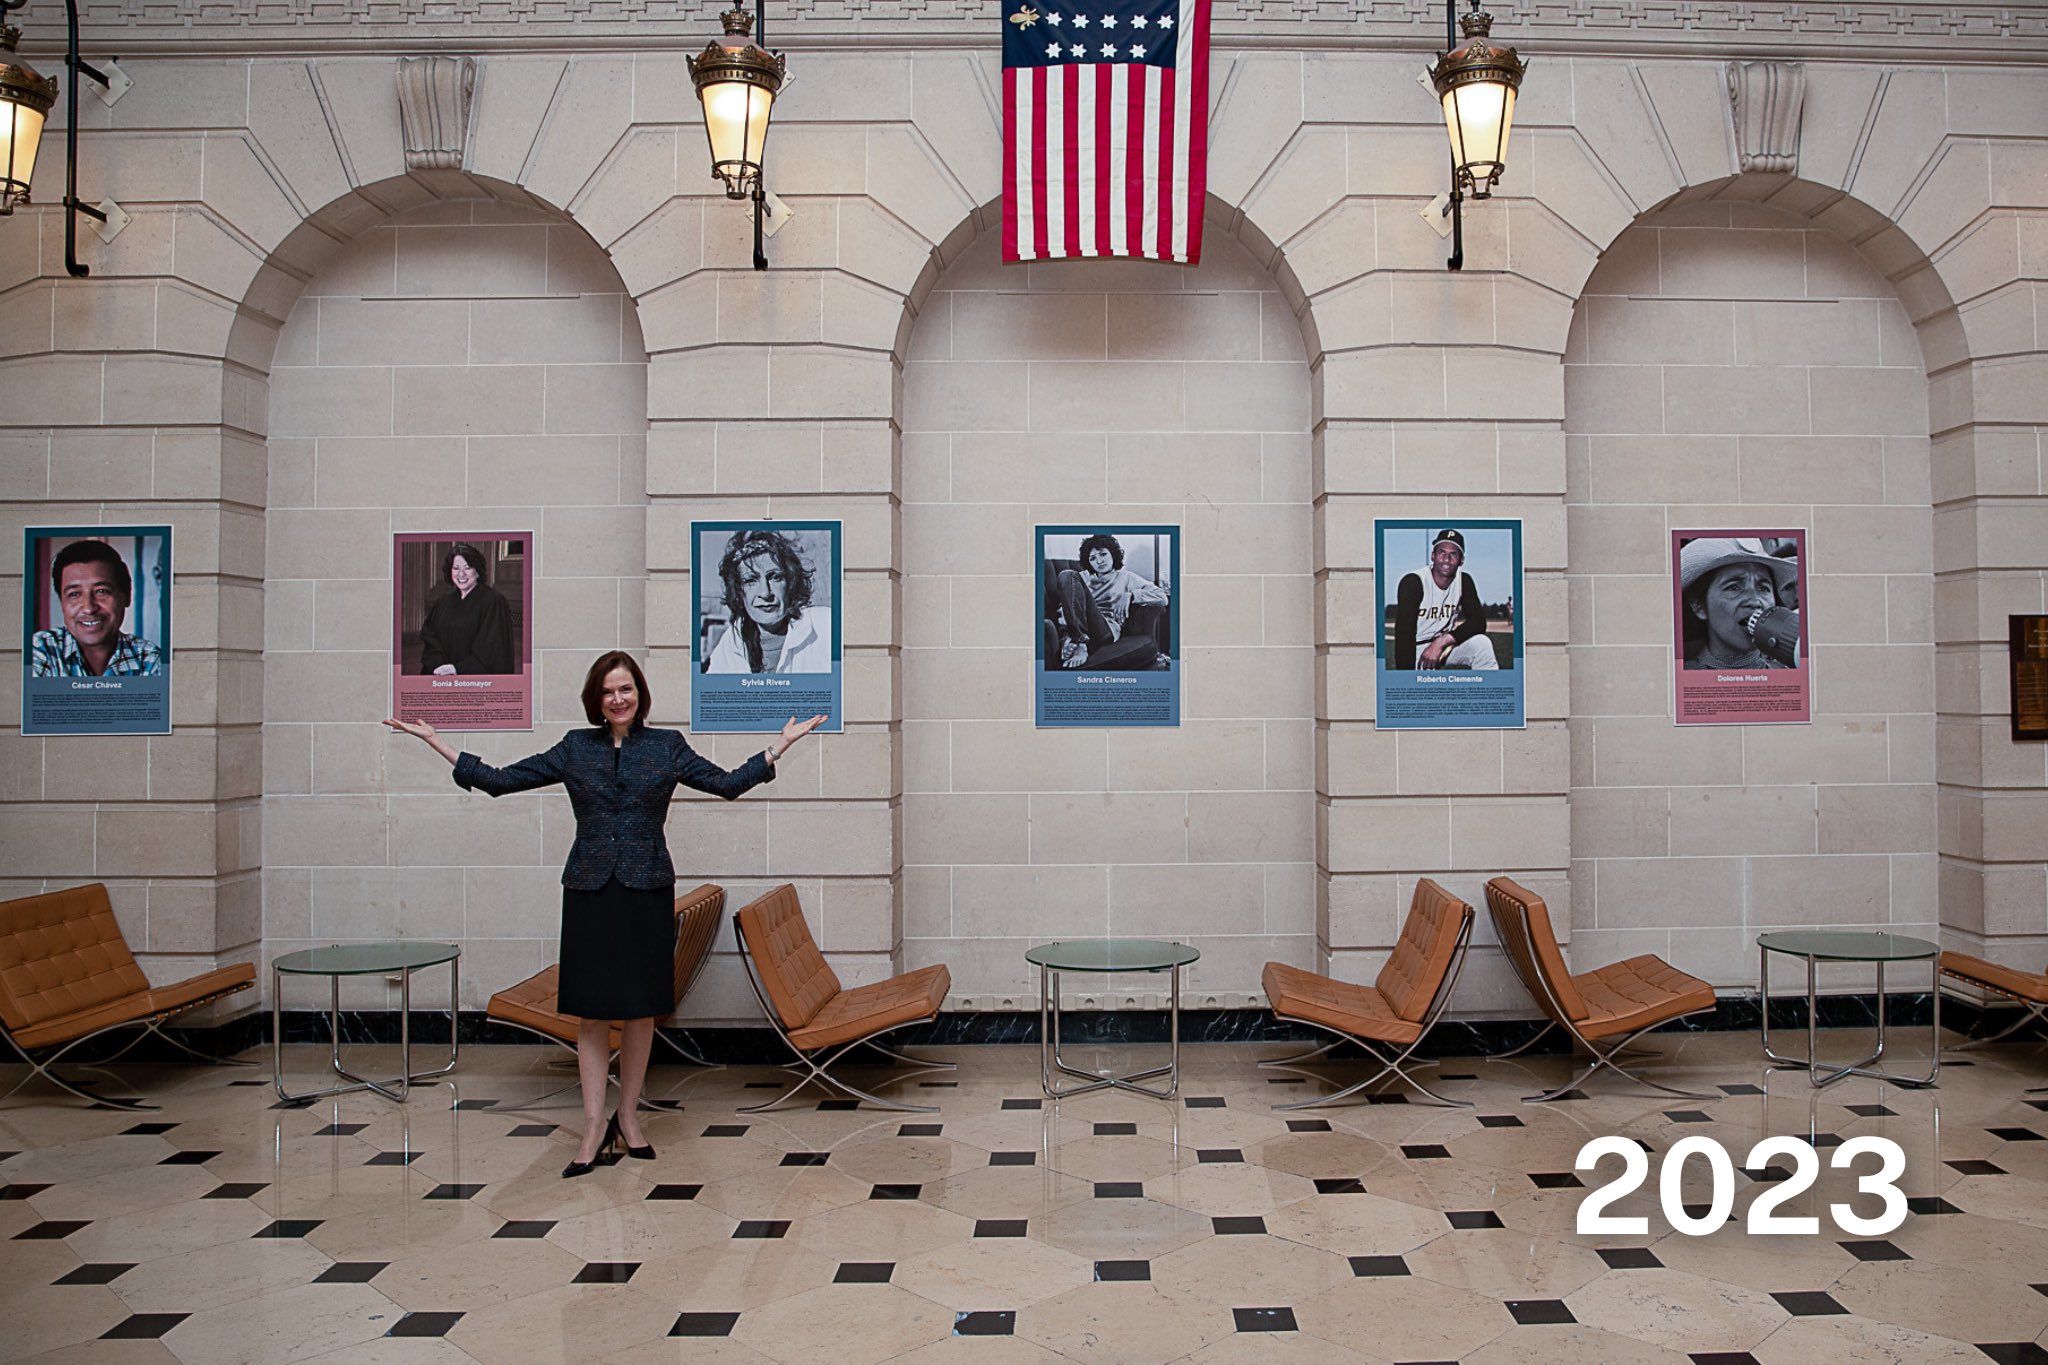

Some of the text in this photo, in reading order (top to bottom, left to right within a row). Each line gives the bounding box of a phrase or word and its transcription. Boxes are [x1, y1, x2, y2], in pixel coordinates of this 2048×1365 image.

[1447, 530, 1455, 538] P
[1416, 675, 1483, 683] Roberto Clemente
[1745, 674, 1768, 682] Huerta
[454, 680, 492, 688] Sotomayor
[741, 678, 790, 687] Sylvia Rivera
